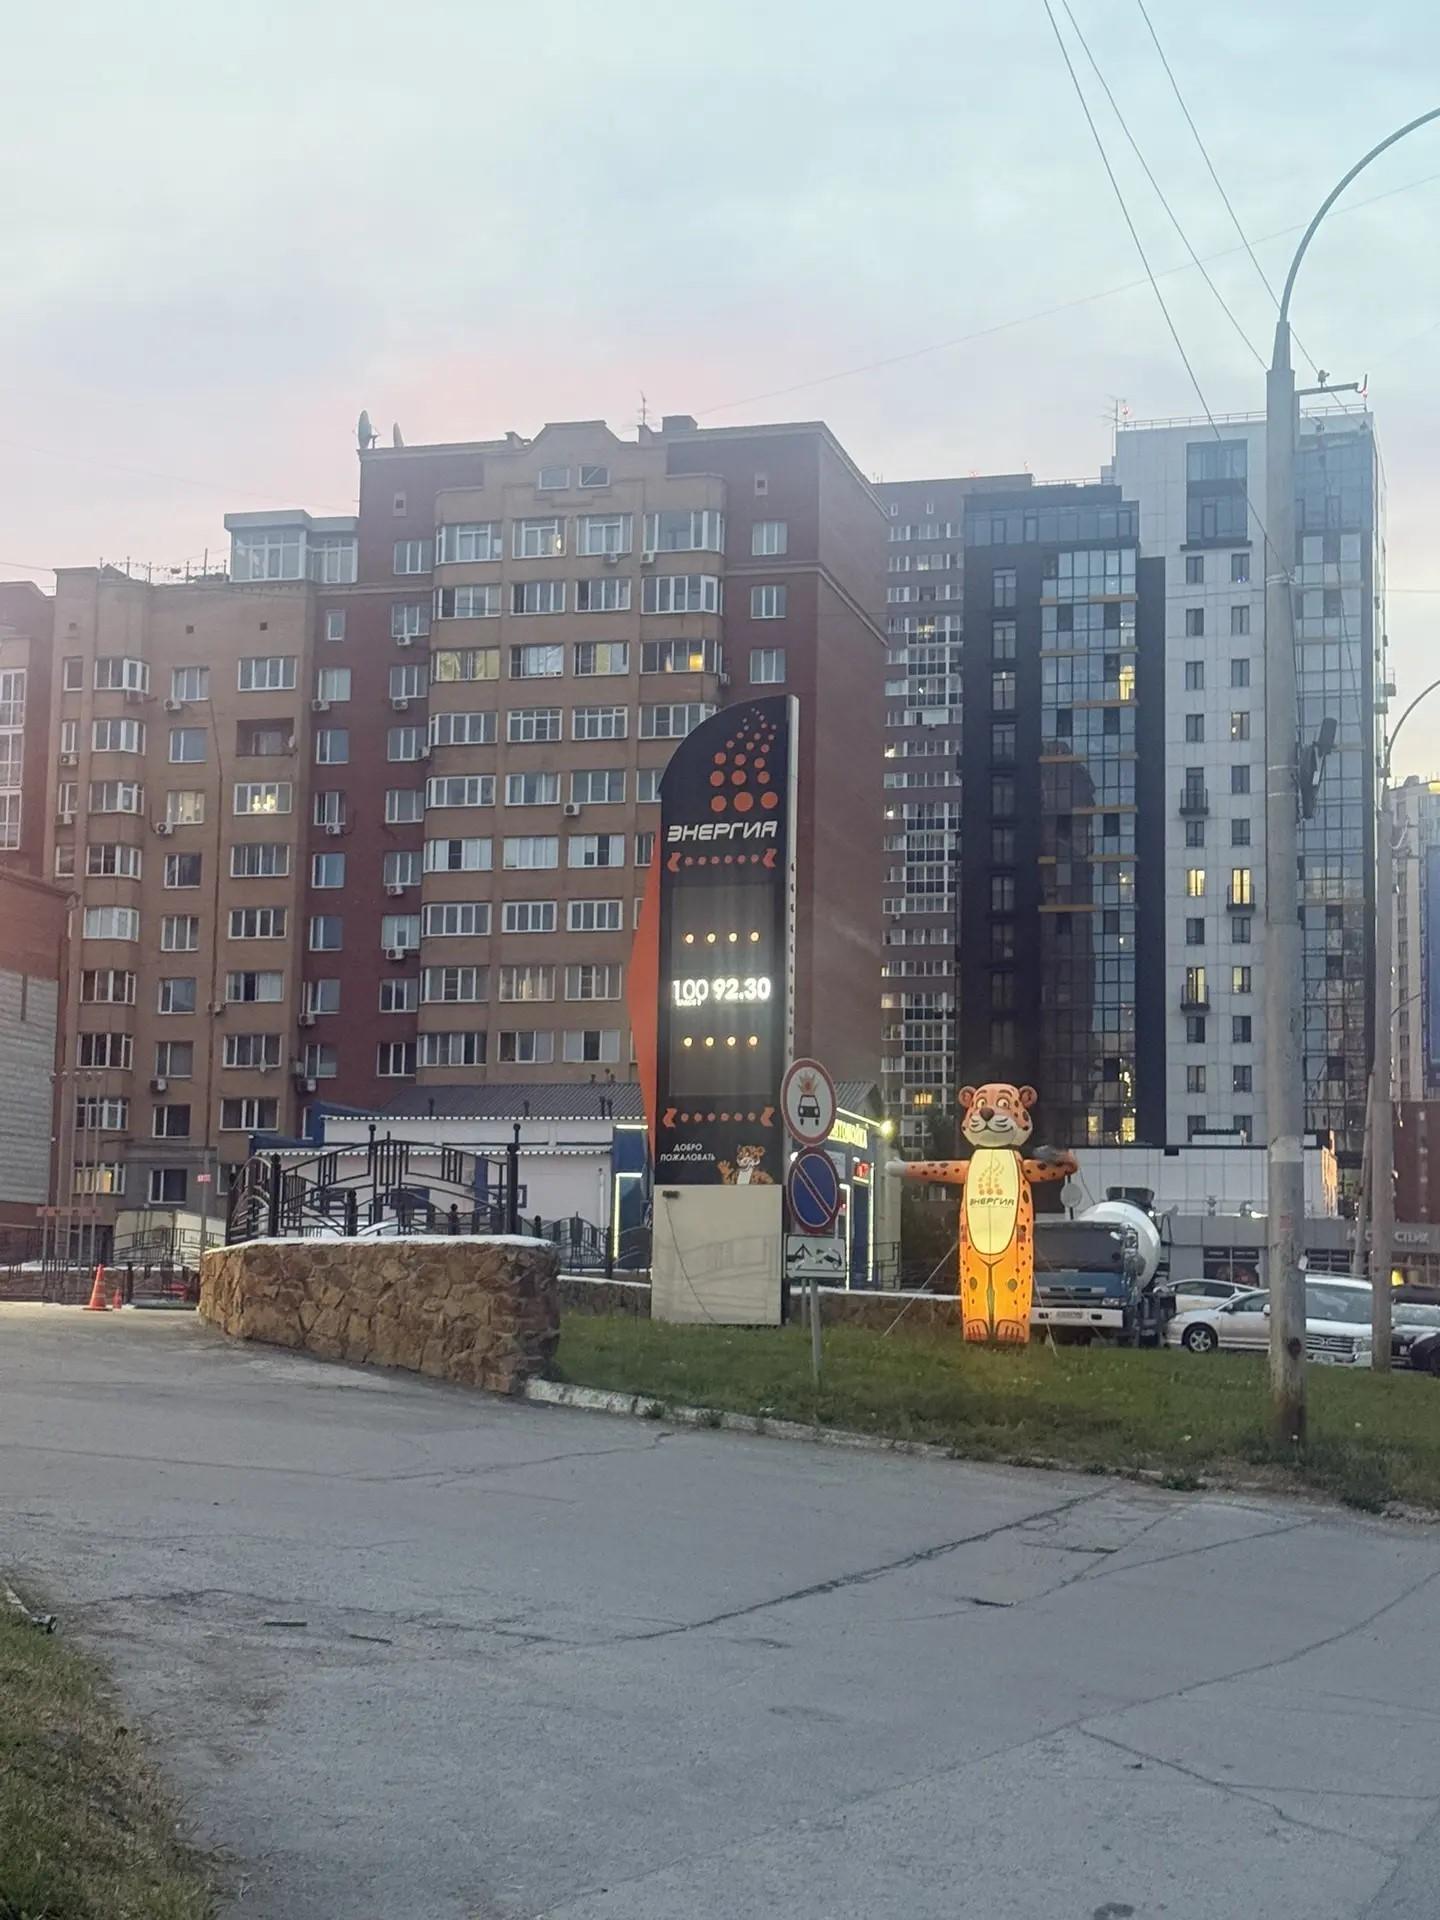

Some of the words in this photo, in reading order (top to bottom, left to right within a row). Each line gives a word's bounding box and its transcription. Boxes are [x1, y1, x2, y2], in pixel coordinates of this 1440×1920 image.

[667, 820, 778, 842] ЭНЕРГИЯ
[672, 978, 709, 1001] 100
[712, 976, 772, 1001] 92.30
[673, 1143, 703, 1152] ДОБРО
[660, 1153, 716, 1162] ПОЖАЛОВАТЬ
[969, 1197, 1015, 1207] ЭНЕРГИЯ
